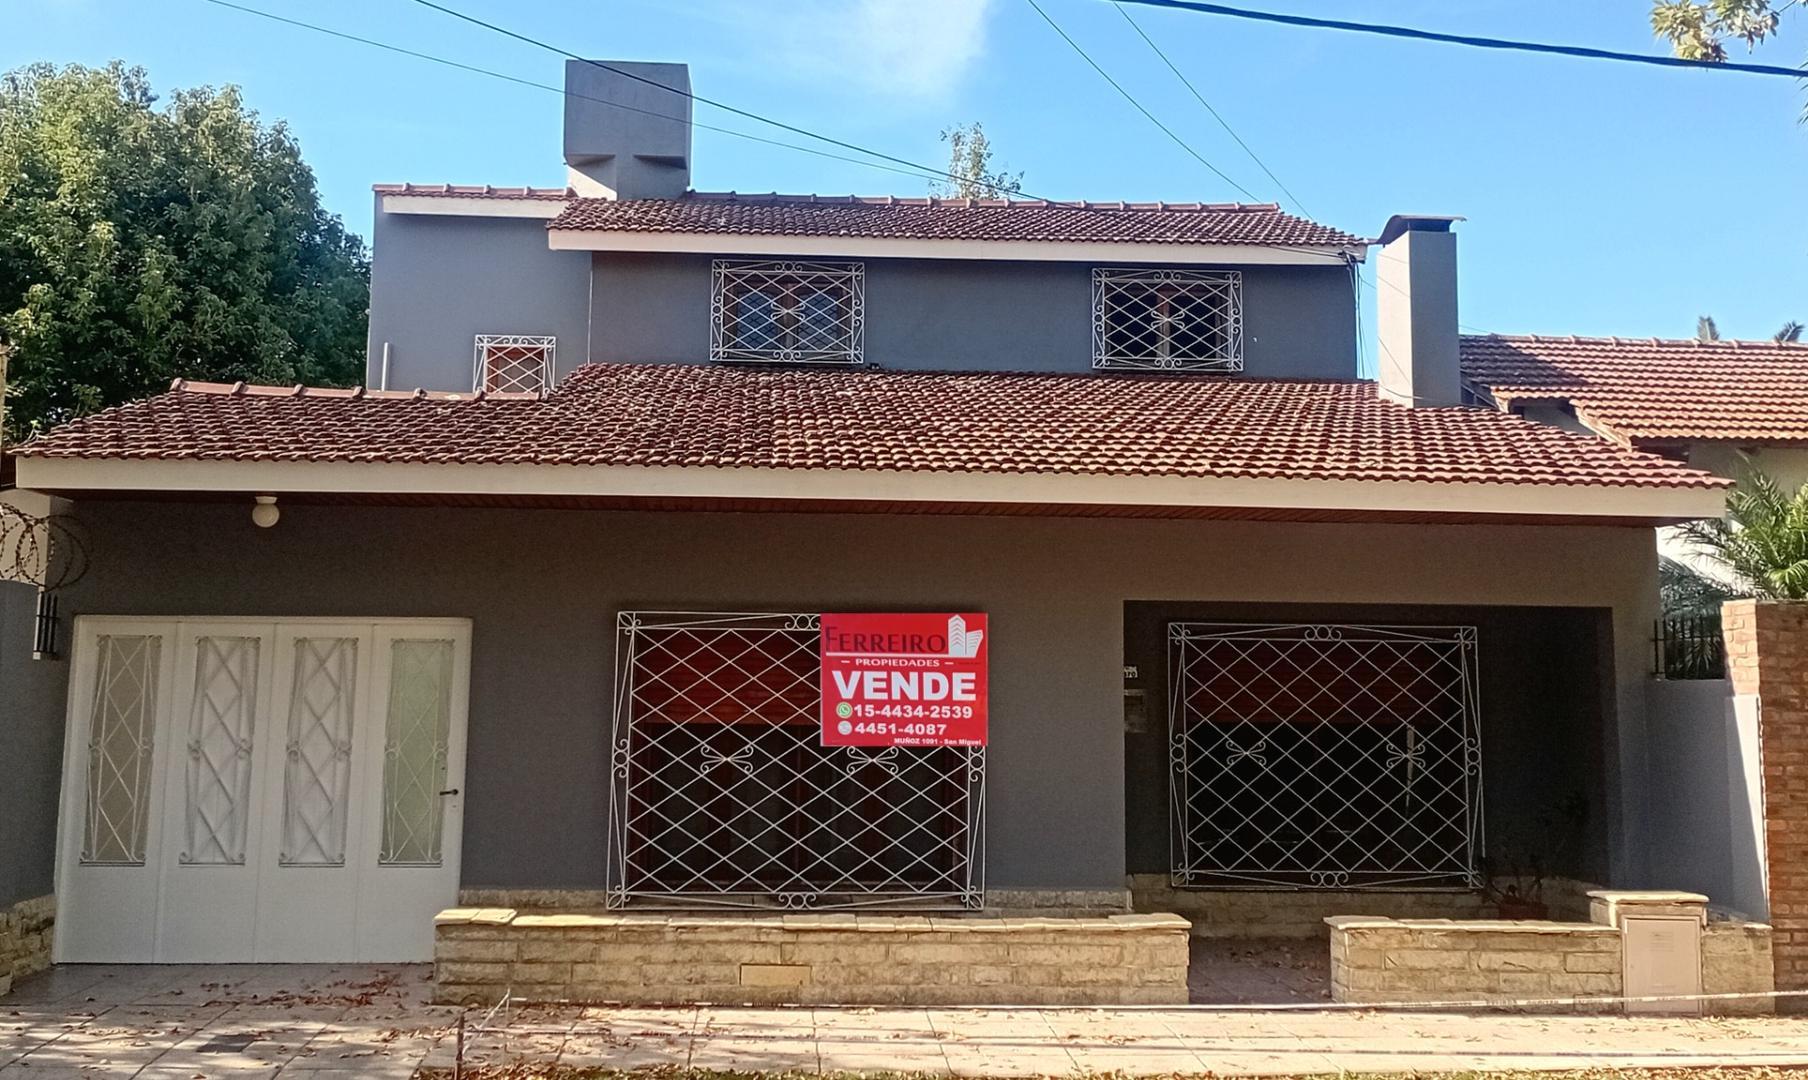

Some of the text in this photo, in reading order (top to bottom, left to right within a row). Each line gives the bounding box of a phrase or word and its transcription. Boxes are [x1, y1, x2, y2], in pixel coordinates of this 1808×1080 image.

[825, 625, 946, 653] FERREIRO
[855, 658, 940, 667] PROPIEDADES
[831, 670, 977, 701] VENDE
[853, 704, 973, 719] 15-4434-2539
[854, 722, 947, 735] 4451-4087
[893, 737, 920, 745] MUÑOZ
[958, 738, 982, 746] Miguel
